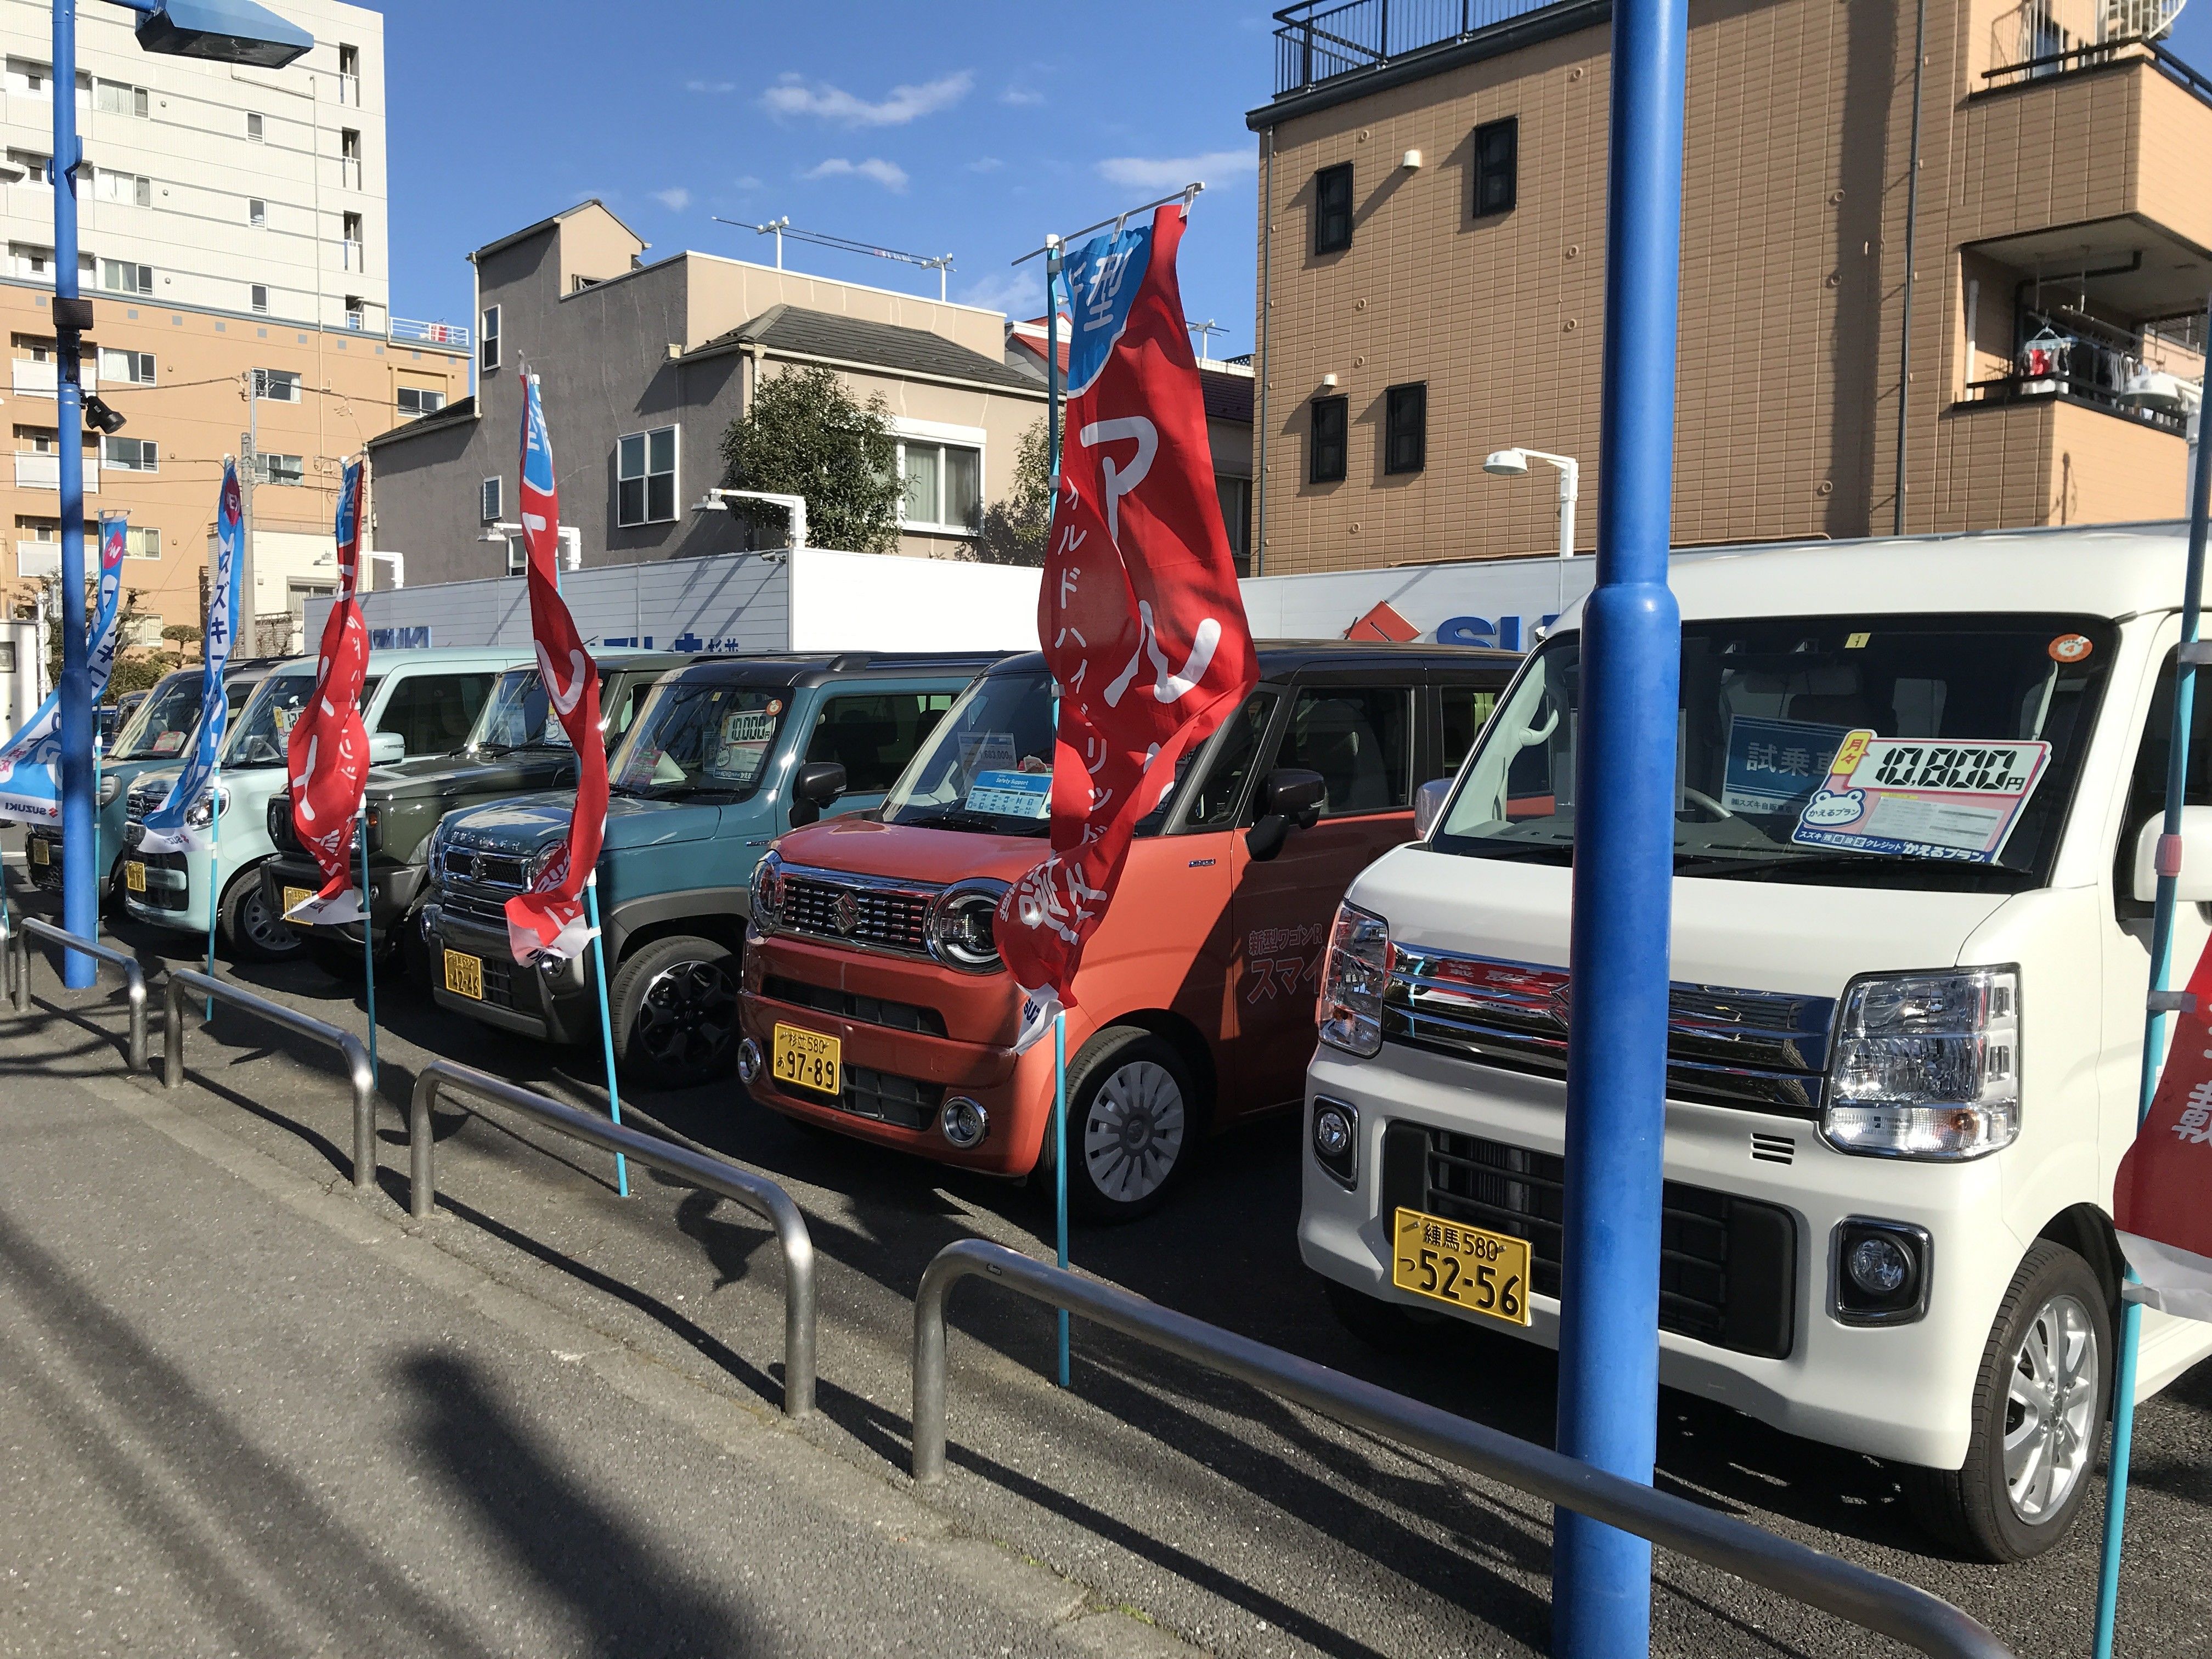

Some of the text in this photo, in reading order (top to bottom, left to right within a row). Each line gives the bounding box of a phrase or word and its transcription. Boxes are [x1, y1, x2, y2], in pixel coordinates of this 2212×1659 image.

[1841, 739, 1864, 765] 月々
[1875, 747, 2025, 791] 10,800円
[1249, 923, 1323, 956] 新型ワゴンR
[808, 1036, 826, 1054] 580
[787, 1050, 836, 1089] 97-89
[1425, 1222, 1499, 1262] 練馬 580
[1400, 1248, 1521, 1316] つ 52-56
